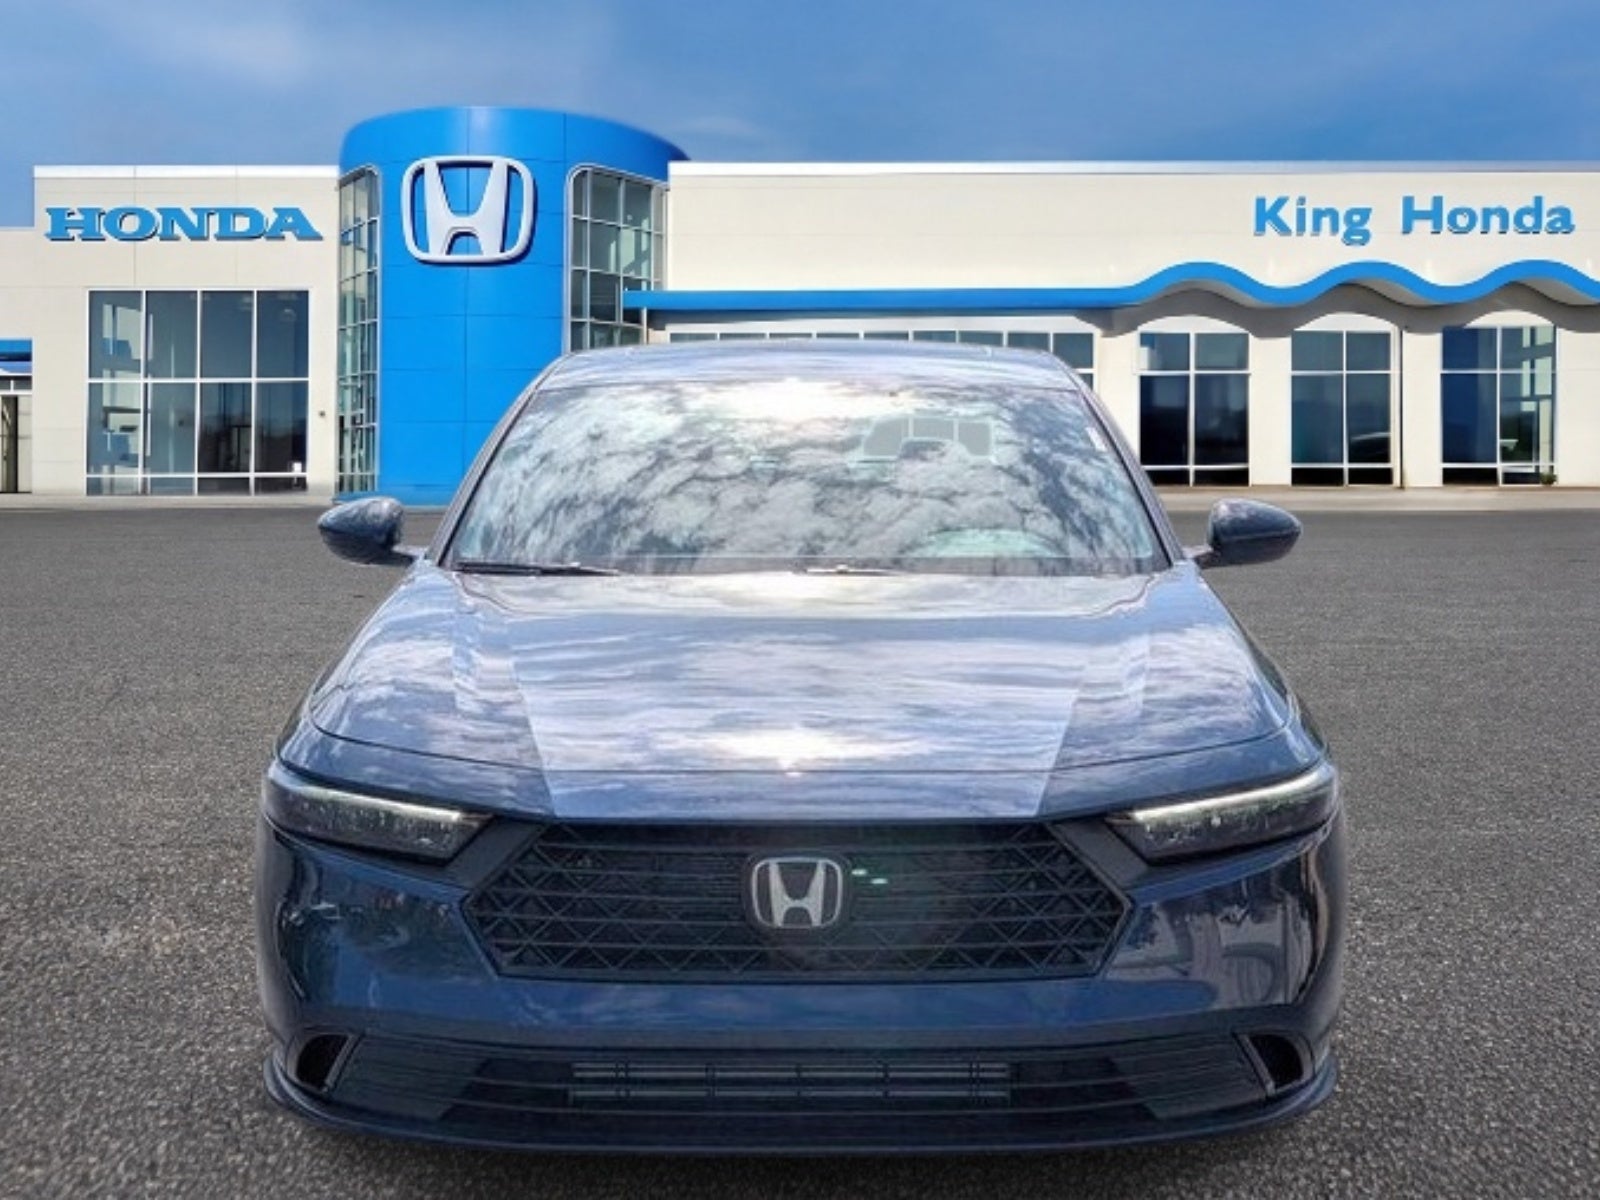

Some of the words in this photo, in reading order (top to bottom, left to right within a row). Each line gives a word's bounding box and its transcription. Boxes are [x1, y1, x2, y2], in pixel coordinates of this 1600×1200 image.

[45, 206, 323, 242] HONDA
[1253, 196, 1373, 246] King
[1401, 195, 1576, 235] Honda
